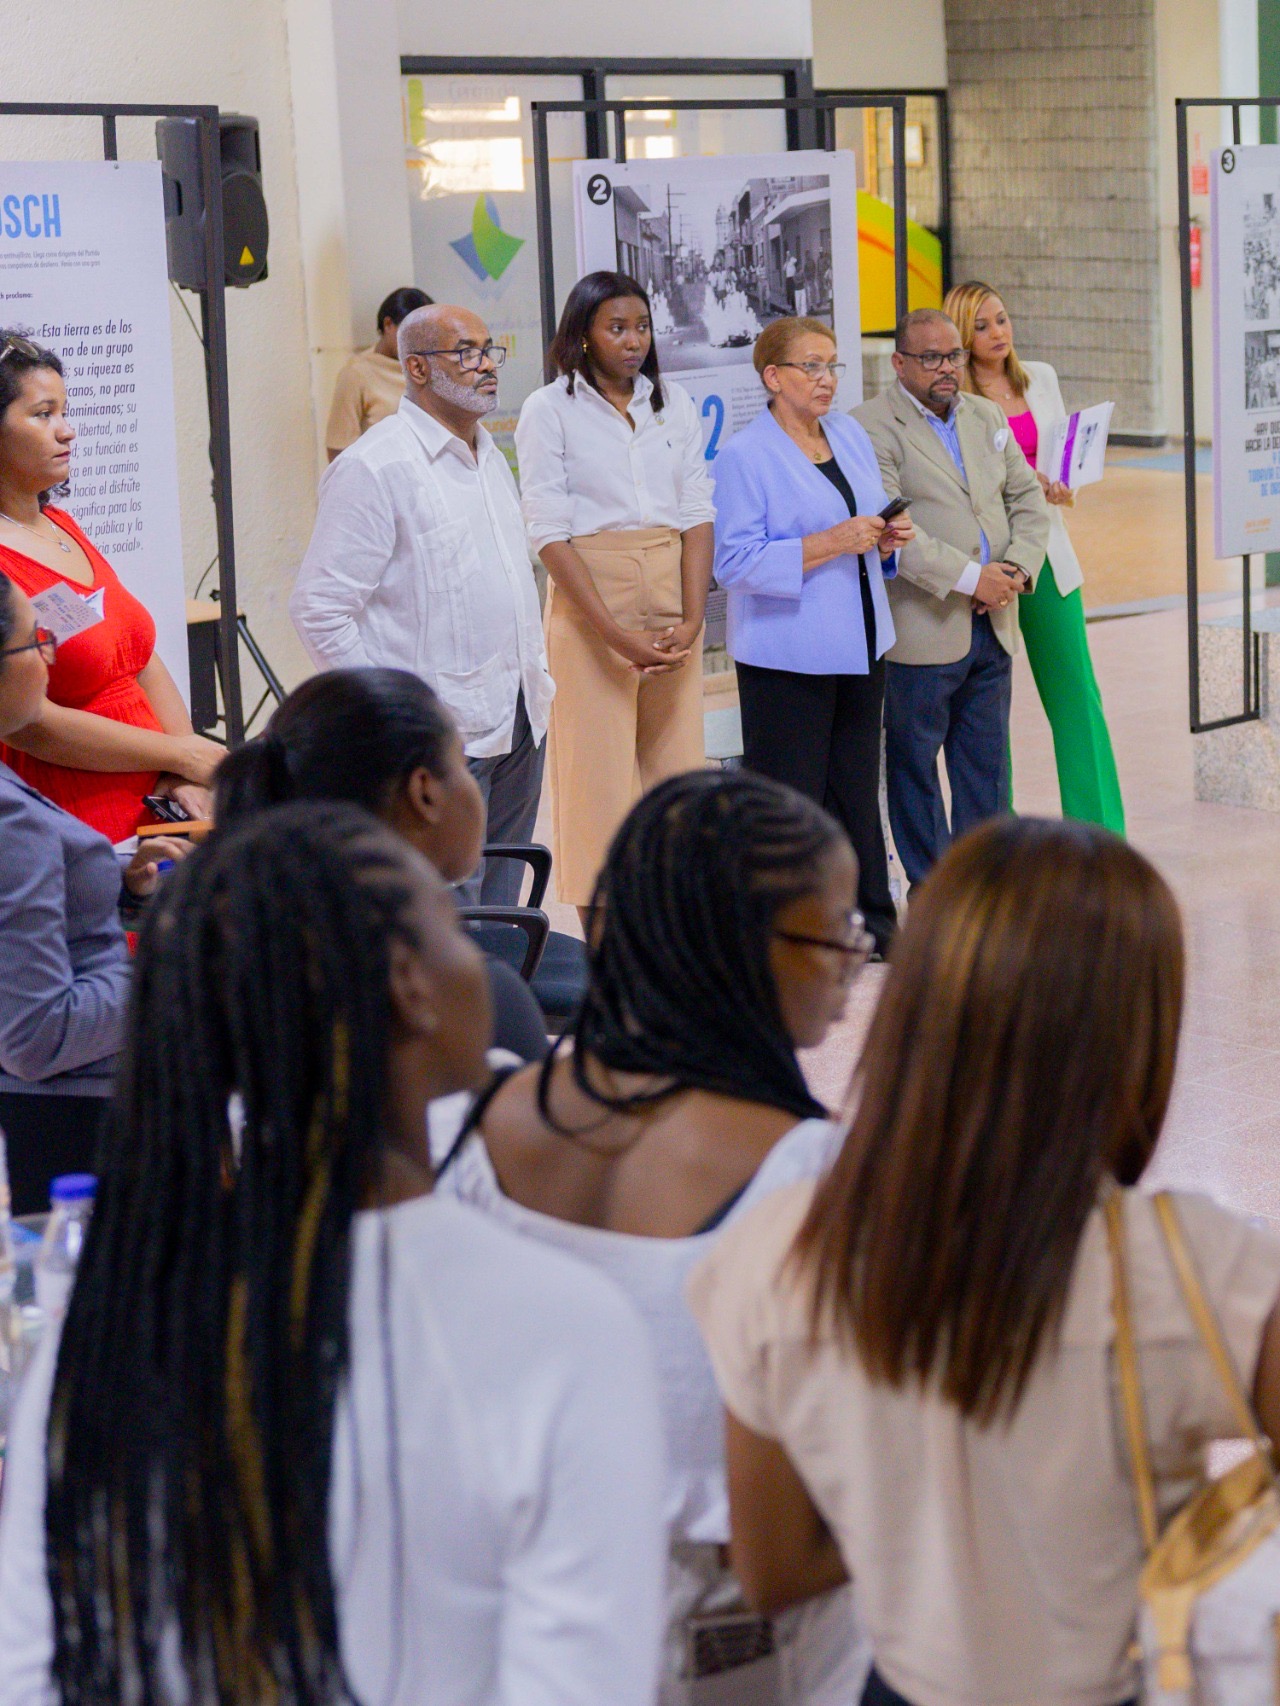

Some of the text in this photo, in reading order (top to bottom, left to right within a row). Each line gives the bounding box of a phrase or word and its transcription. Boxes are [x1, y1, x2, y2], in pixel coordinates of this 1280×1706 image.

[592, 178, 607, 201] 2
[0, 194, 61, 238] SCH
[64, 323, 89, 337] tierra
[93, 325, 102, 335] es
[105, 319, 117, 334] de
[119, 318, 132, 334] los
[62, 346, 74, 357] no
[77, 341, 88, 356] de
[91, 345, 103, 355] un
[106, 343, 133, 358] grupo
[73, 366, 84, 377] su
[87, 362, 121, 378] riqueza
[124, 363, 134, 374] es
[66, 383, 135, 398] icanos, no para
[127, 403, 137, 414] su
[78, 420, 113, 437] libertad,
[116, 423, 127, 433] no
[130, 418, 138, 433] el
[83, 445, 93, 457] su
[95, 440, 125, 456] función
[129, 442, 138, 453] es
[82, 466, 93, 476] en
[95, 465, 106, 476] un
[108, 460, 139, 475] camino
[74, 478, 141, 498] hacia el disfrute
[71, 498, 142, 520] significa para los
[95, 519, 125, 537] pública
[127, 524, 133, 535] y
[135, 517, 143, 531] la
